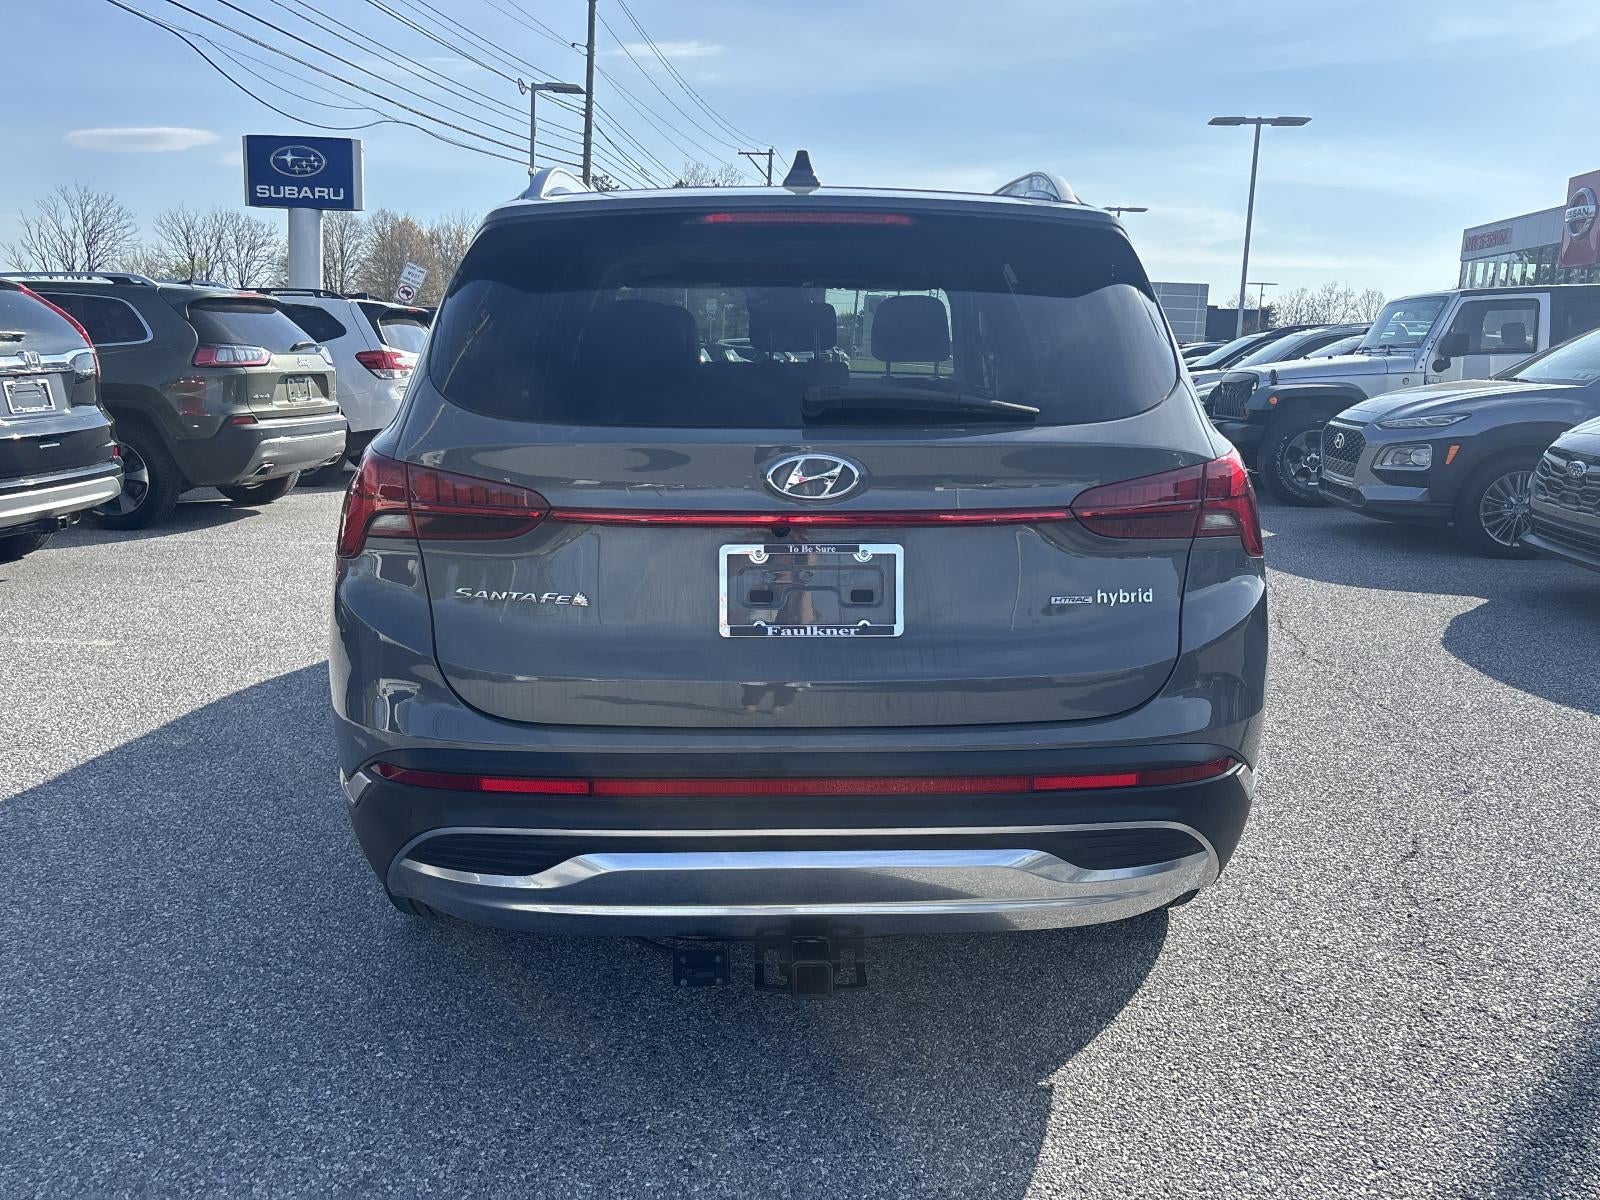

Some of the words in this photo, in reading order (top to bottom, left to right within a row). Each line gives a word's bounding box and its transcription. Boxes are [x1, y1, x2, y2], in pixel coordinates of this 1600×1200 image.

[256, 185, 344, 200] SUBARU
[787, 545, 800, 553] To
[801, 545, 813, 553] Be
[815, 545, 836, 553] Sure
[1097, 588, 1153, 607] hybrid
[767, 626, 860, 636] Faulkner
